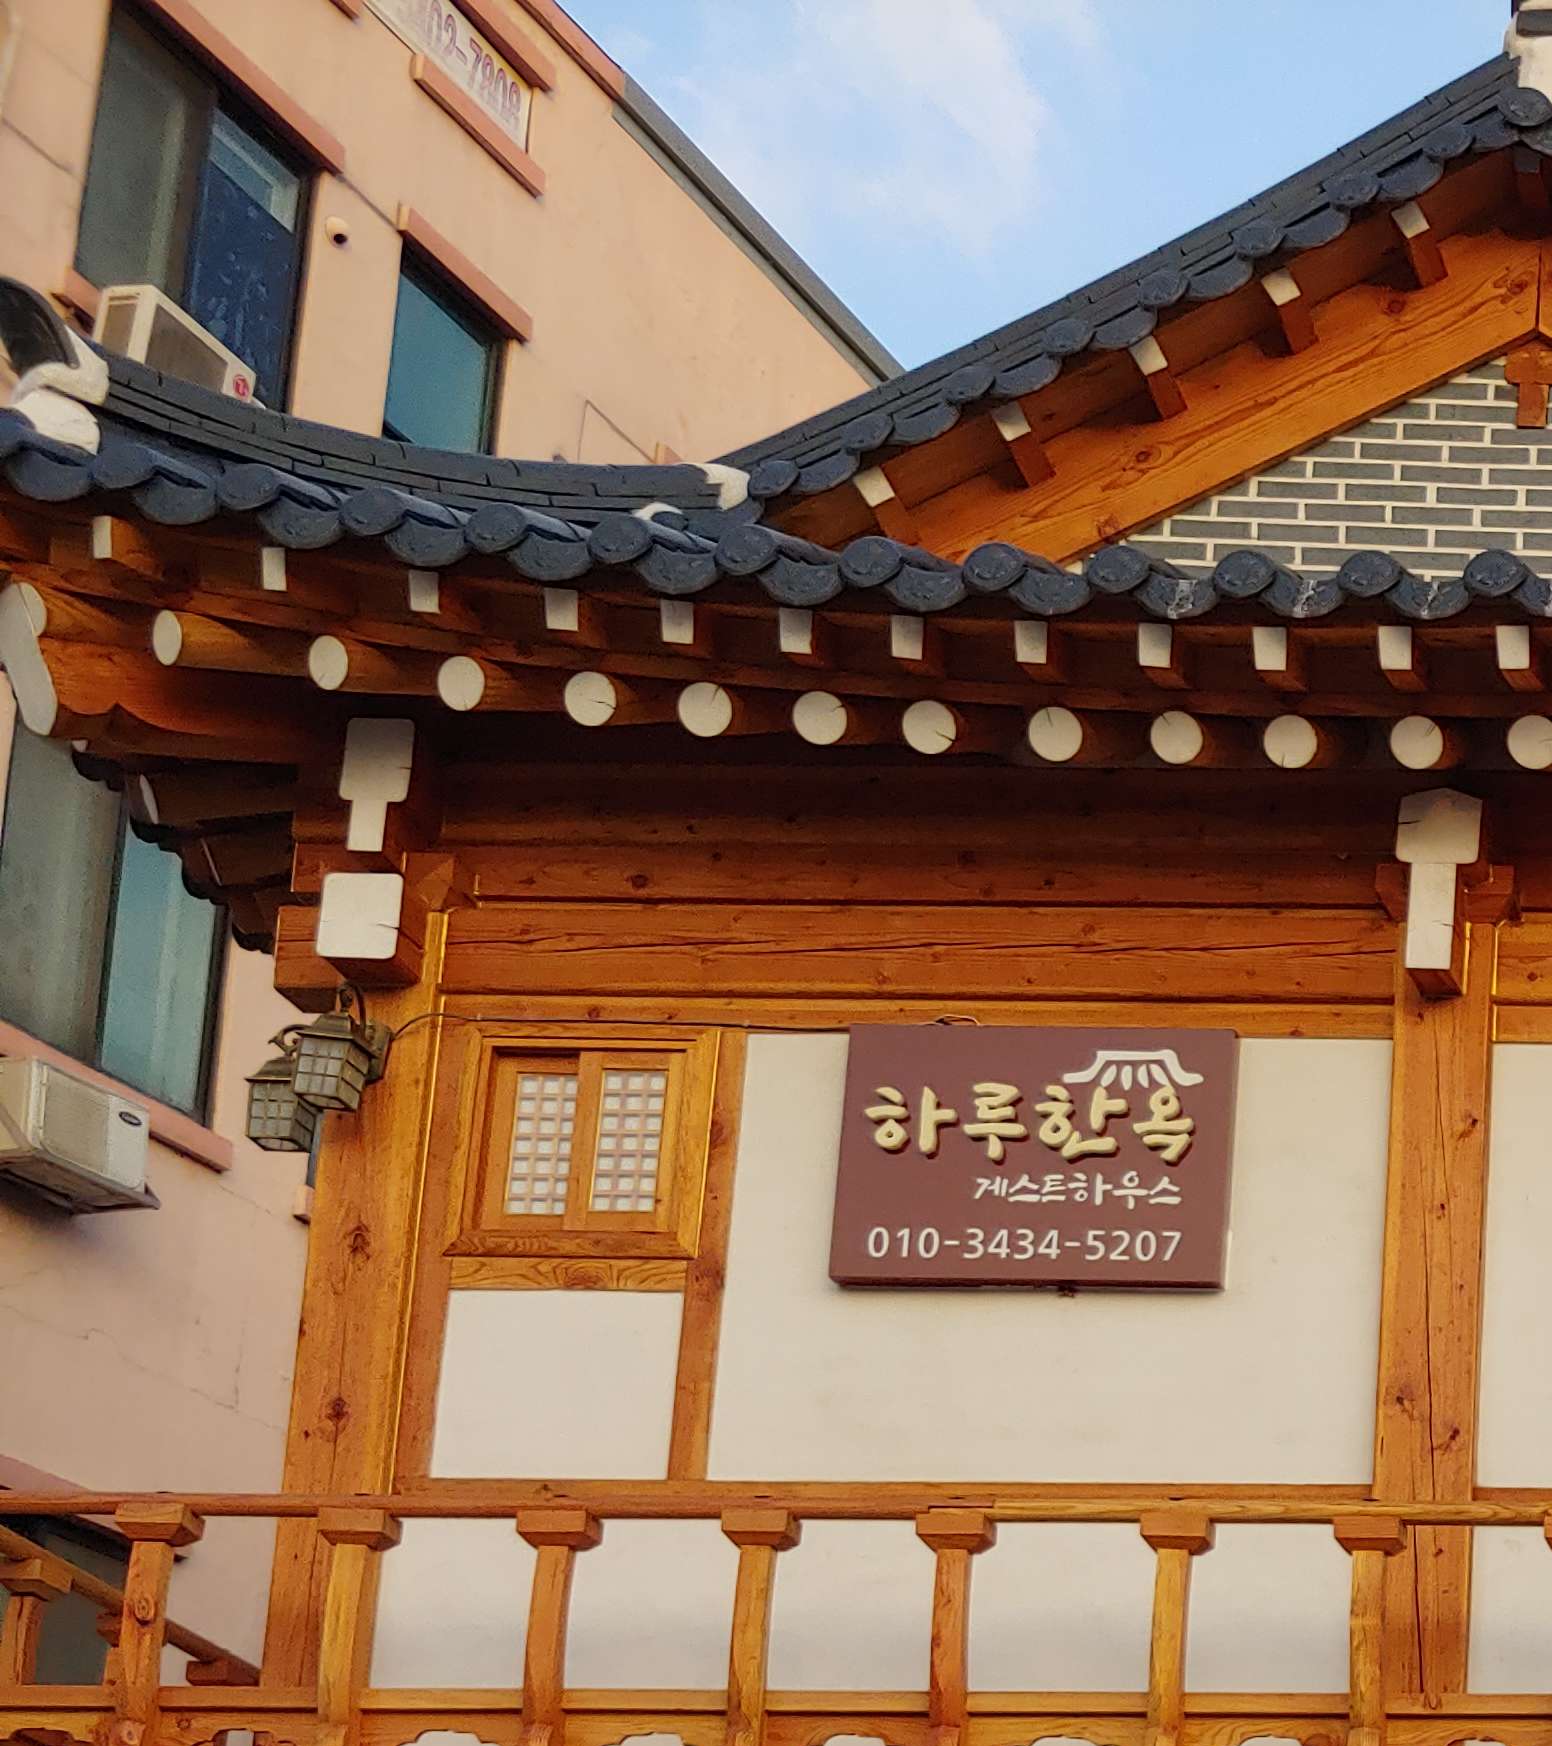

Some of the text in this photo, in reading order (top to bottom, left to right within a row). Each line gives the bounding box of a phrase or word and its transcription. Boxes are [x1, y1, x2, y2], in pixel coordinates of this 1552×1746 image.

[864, 1082, 1195, 1164] 하루한옥
[973, 1170, 1183, 1210] 게스트하우스
[866, 1226, 1183, 1262] 010-3434-5207
